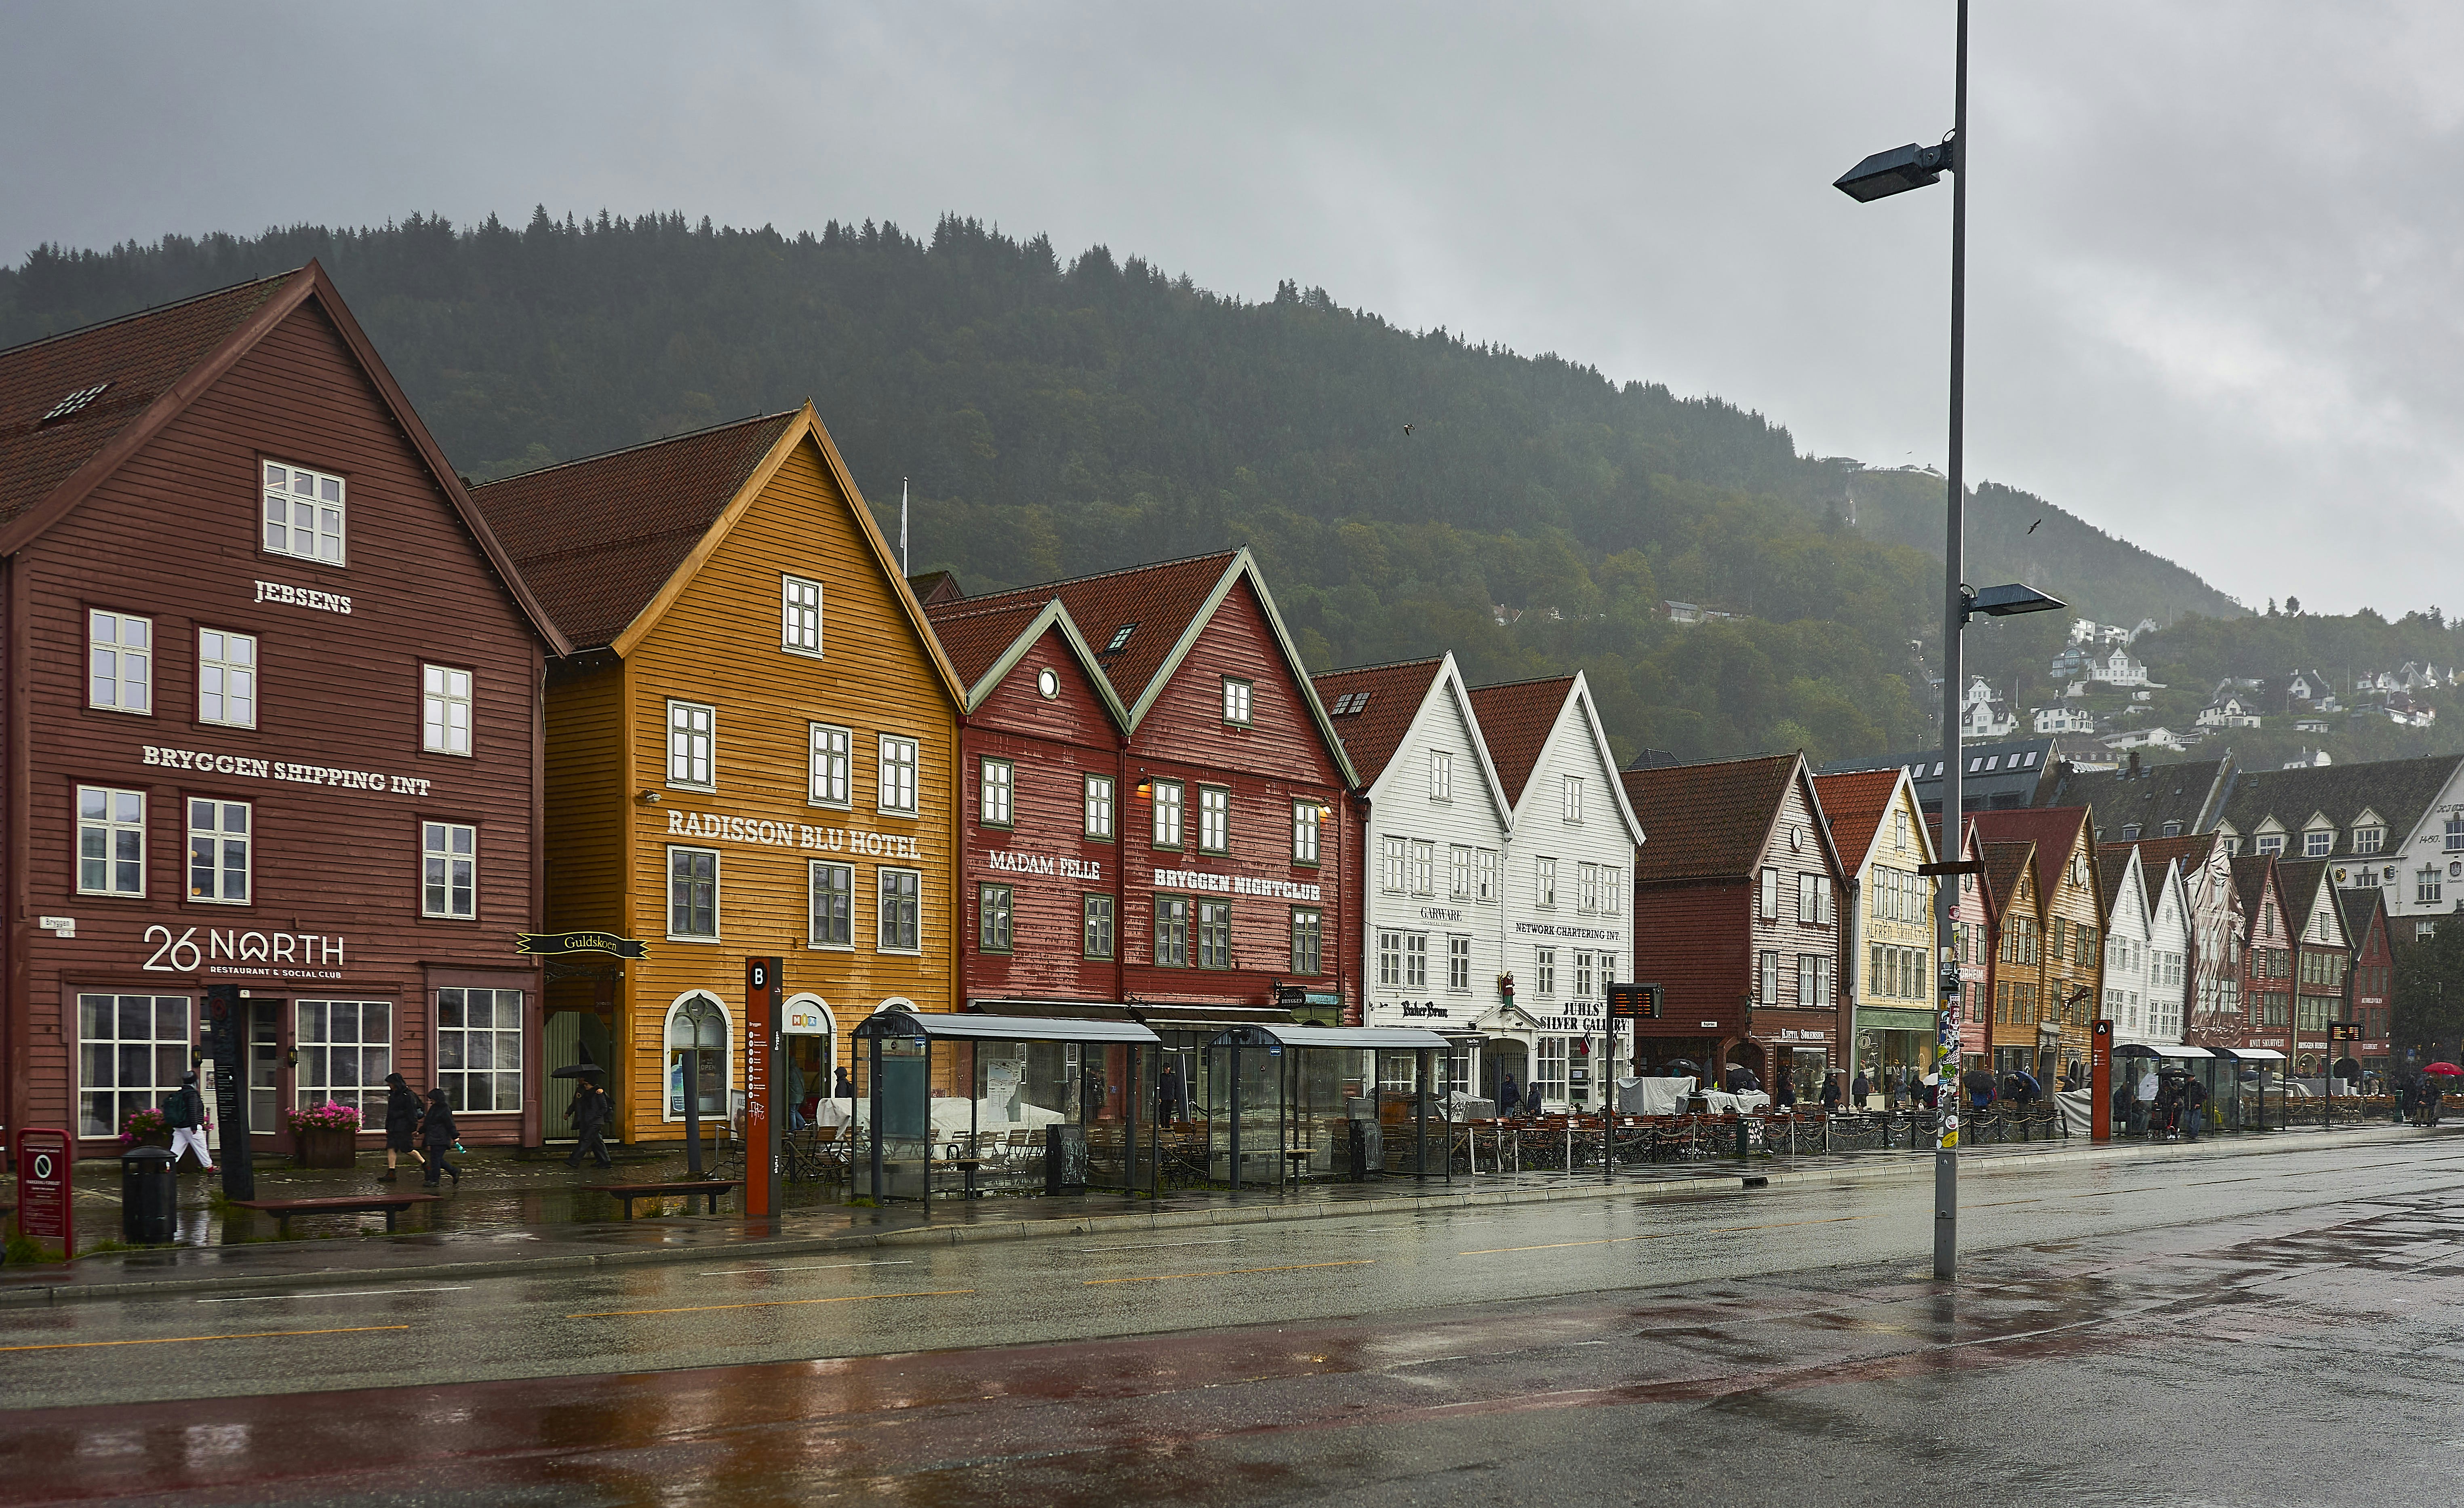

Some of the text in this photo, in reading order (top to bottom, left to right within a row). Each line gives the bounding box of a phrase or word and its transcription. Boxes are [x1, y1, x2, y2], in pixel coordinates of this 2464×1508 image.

[254, 580, 351, 614] JEBSENS
[142, 746, 430, 796] BRYGGEN SHIPPING INT
[667, 810, 921, 859] RADISSON BLU HOTEL
[990, 850, 1100, 880] MADAM FELLE
[1154, 868, 1320, 901] BRYGGEN NIGHTCLUB
[1421, 907, 1462, 921] GARWARE
[46, 918, 70, 927] Bryggen
[1516, 922, 1621, 940] NETWORK CHARTERING INT.
[1866, 923, 1931, 944] ALFRED SKULSTAD
[143, 925, 343, 971] 26 NORTH
[564, 935, 617, 951] Guldskoen
[210, 966, 270, 975] RESTAURANT
[755, 968, 763, 984] B
[1401, 1000, 1449, 1019] Baker Brun
[1563, 1003, 1603, 1016] JUHLS'
[793, 1014, 816, 1026] MIX
[1540, 1016, 1628, 1031] SILVER GALLRY
[1781, 1028, 1799, 1039] KJETIL
[2249, 1039, 2261, 1047] KNUT
